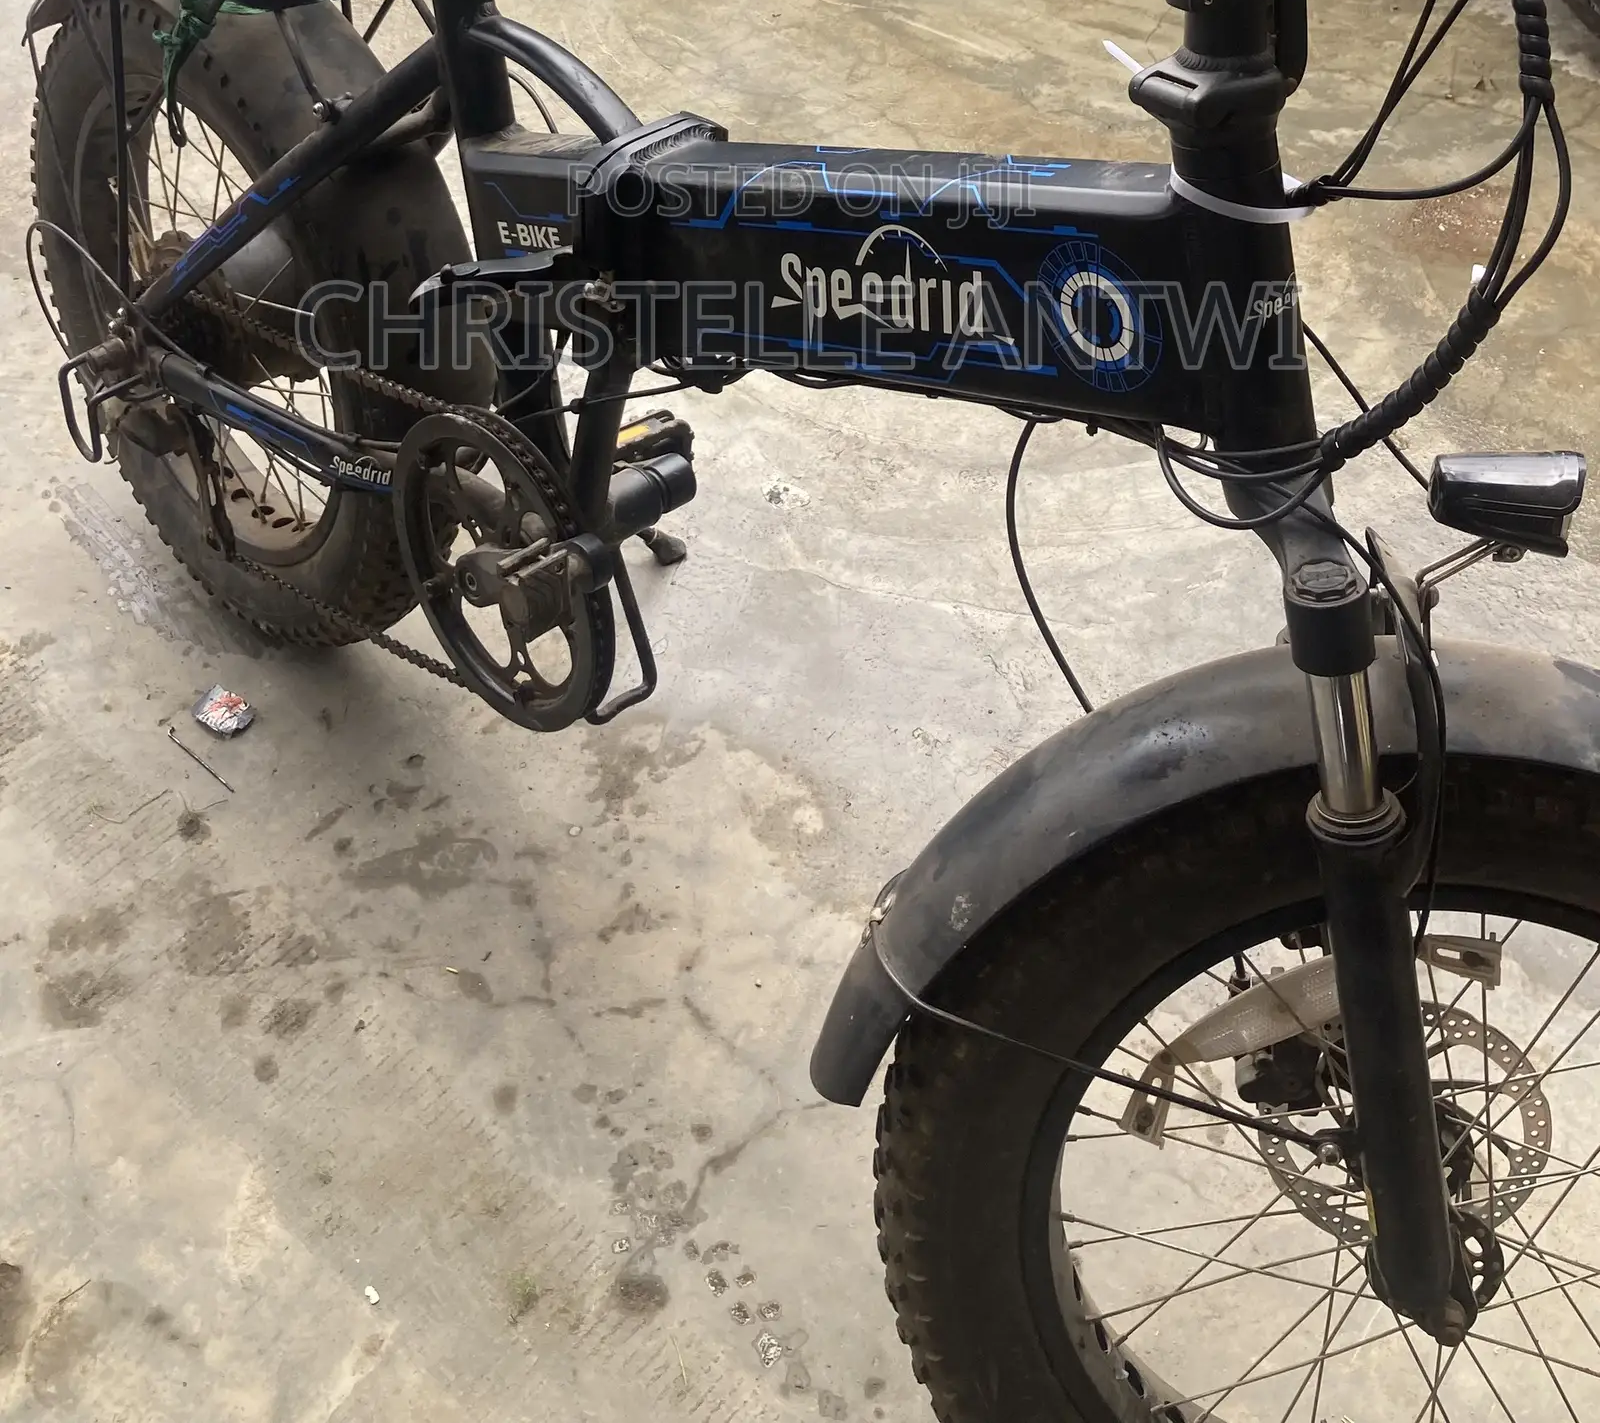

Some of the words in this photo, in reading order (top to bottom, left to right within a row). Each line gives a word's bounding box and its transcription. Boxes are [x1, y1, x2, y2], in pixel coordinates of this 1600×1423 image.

[497, 221, 562, 249] E-BIKE
[771, 240, 1015, 349] Speedrid
[329, 455, 391, 485] Speedrid
